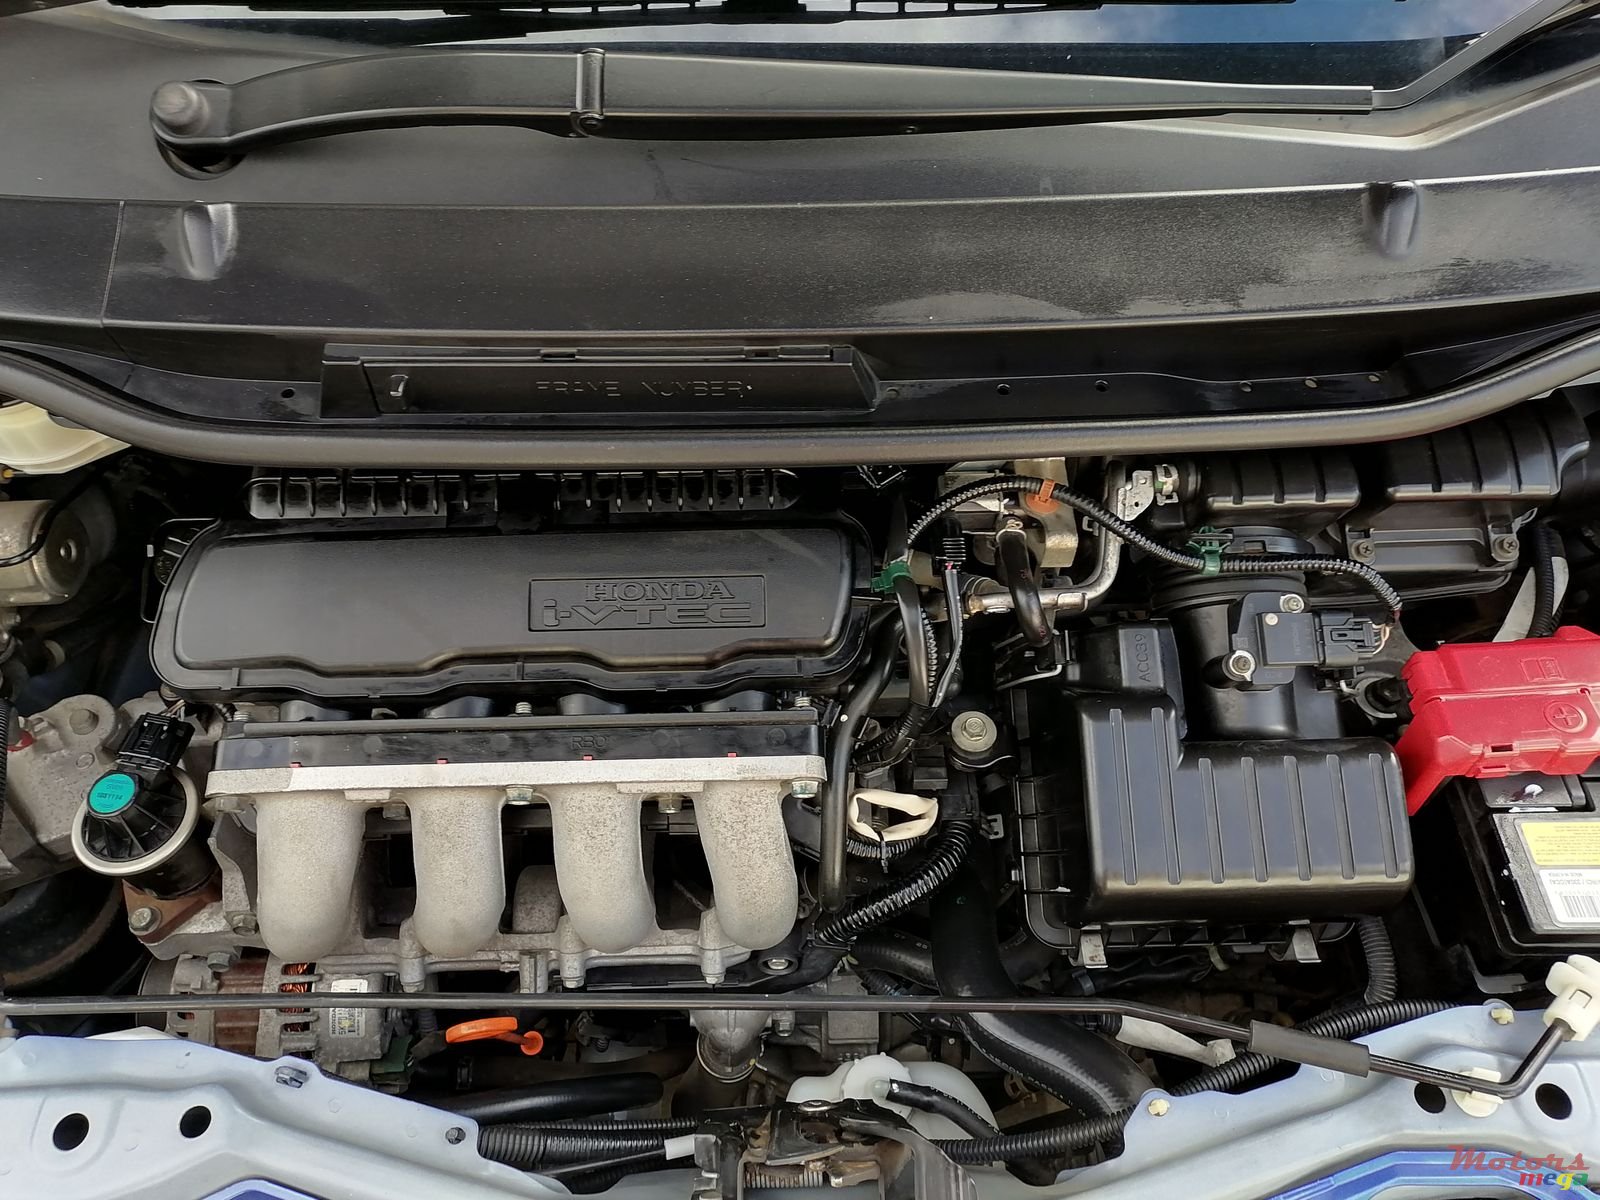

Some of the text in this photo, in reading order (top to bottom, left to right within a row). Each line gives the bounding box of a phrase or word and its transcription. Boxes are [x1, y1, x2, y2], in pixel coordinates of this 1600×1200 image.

[535, 380, 744, 398] FRAME NUMBER
[585, 580, 735, 602] HONDA
[541, 599, 752, 627] i-VTEC
